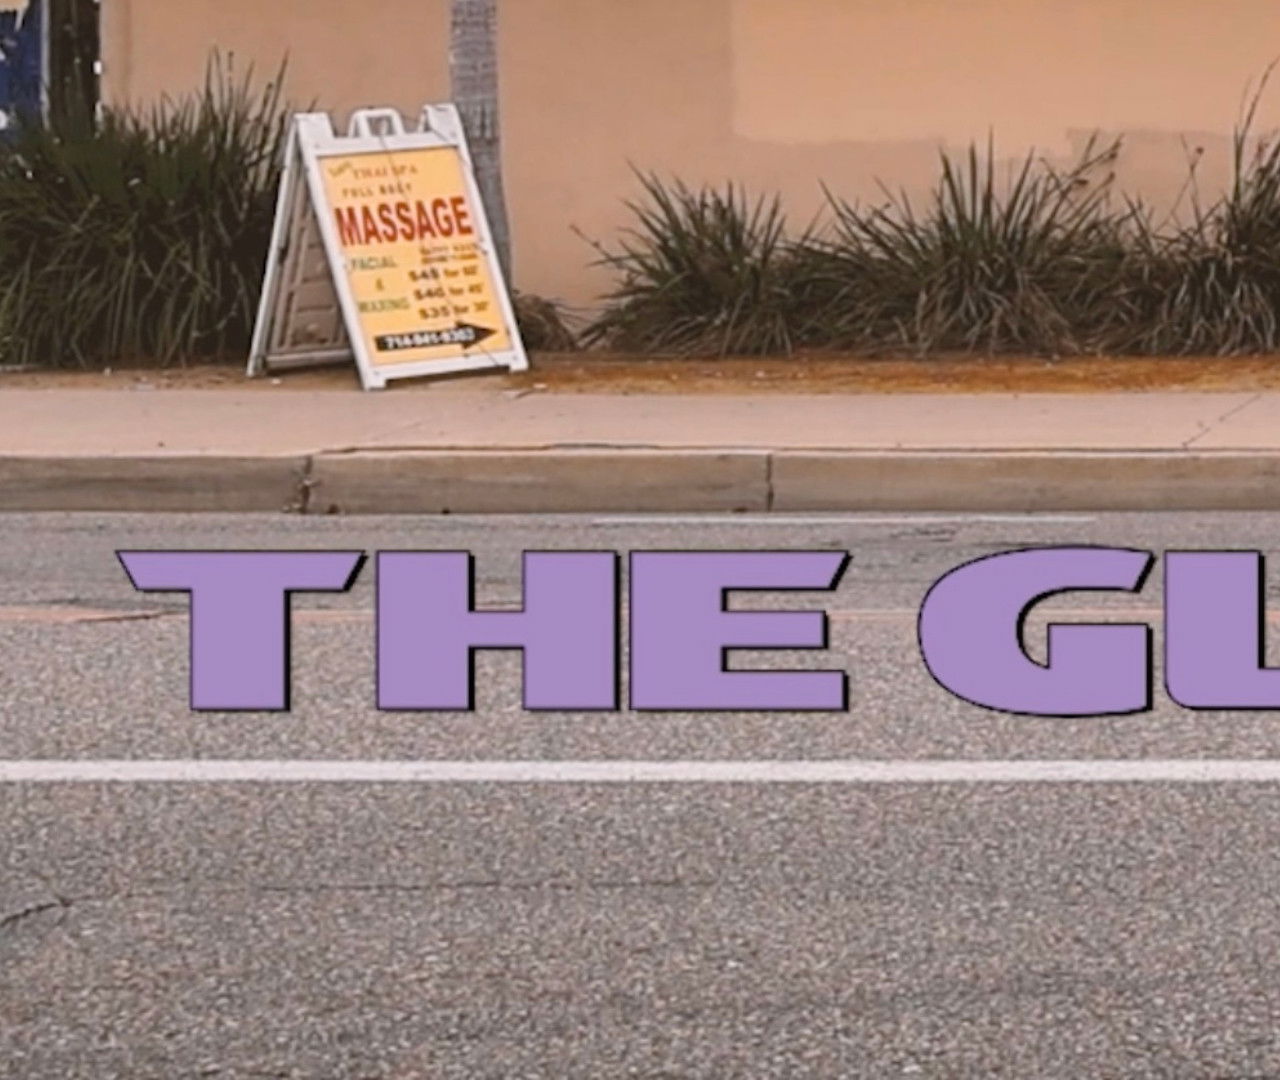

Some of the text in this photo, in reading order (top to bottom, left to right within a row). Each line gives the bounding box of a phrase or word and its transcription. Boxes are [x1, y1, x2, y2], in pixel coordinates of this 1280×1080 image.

[334, 196, 473, 246] MASSAGE
[350, 255, 397, 270] FACIAL
[358, 296, 411, 313] WAXING
